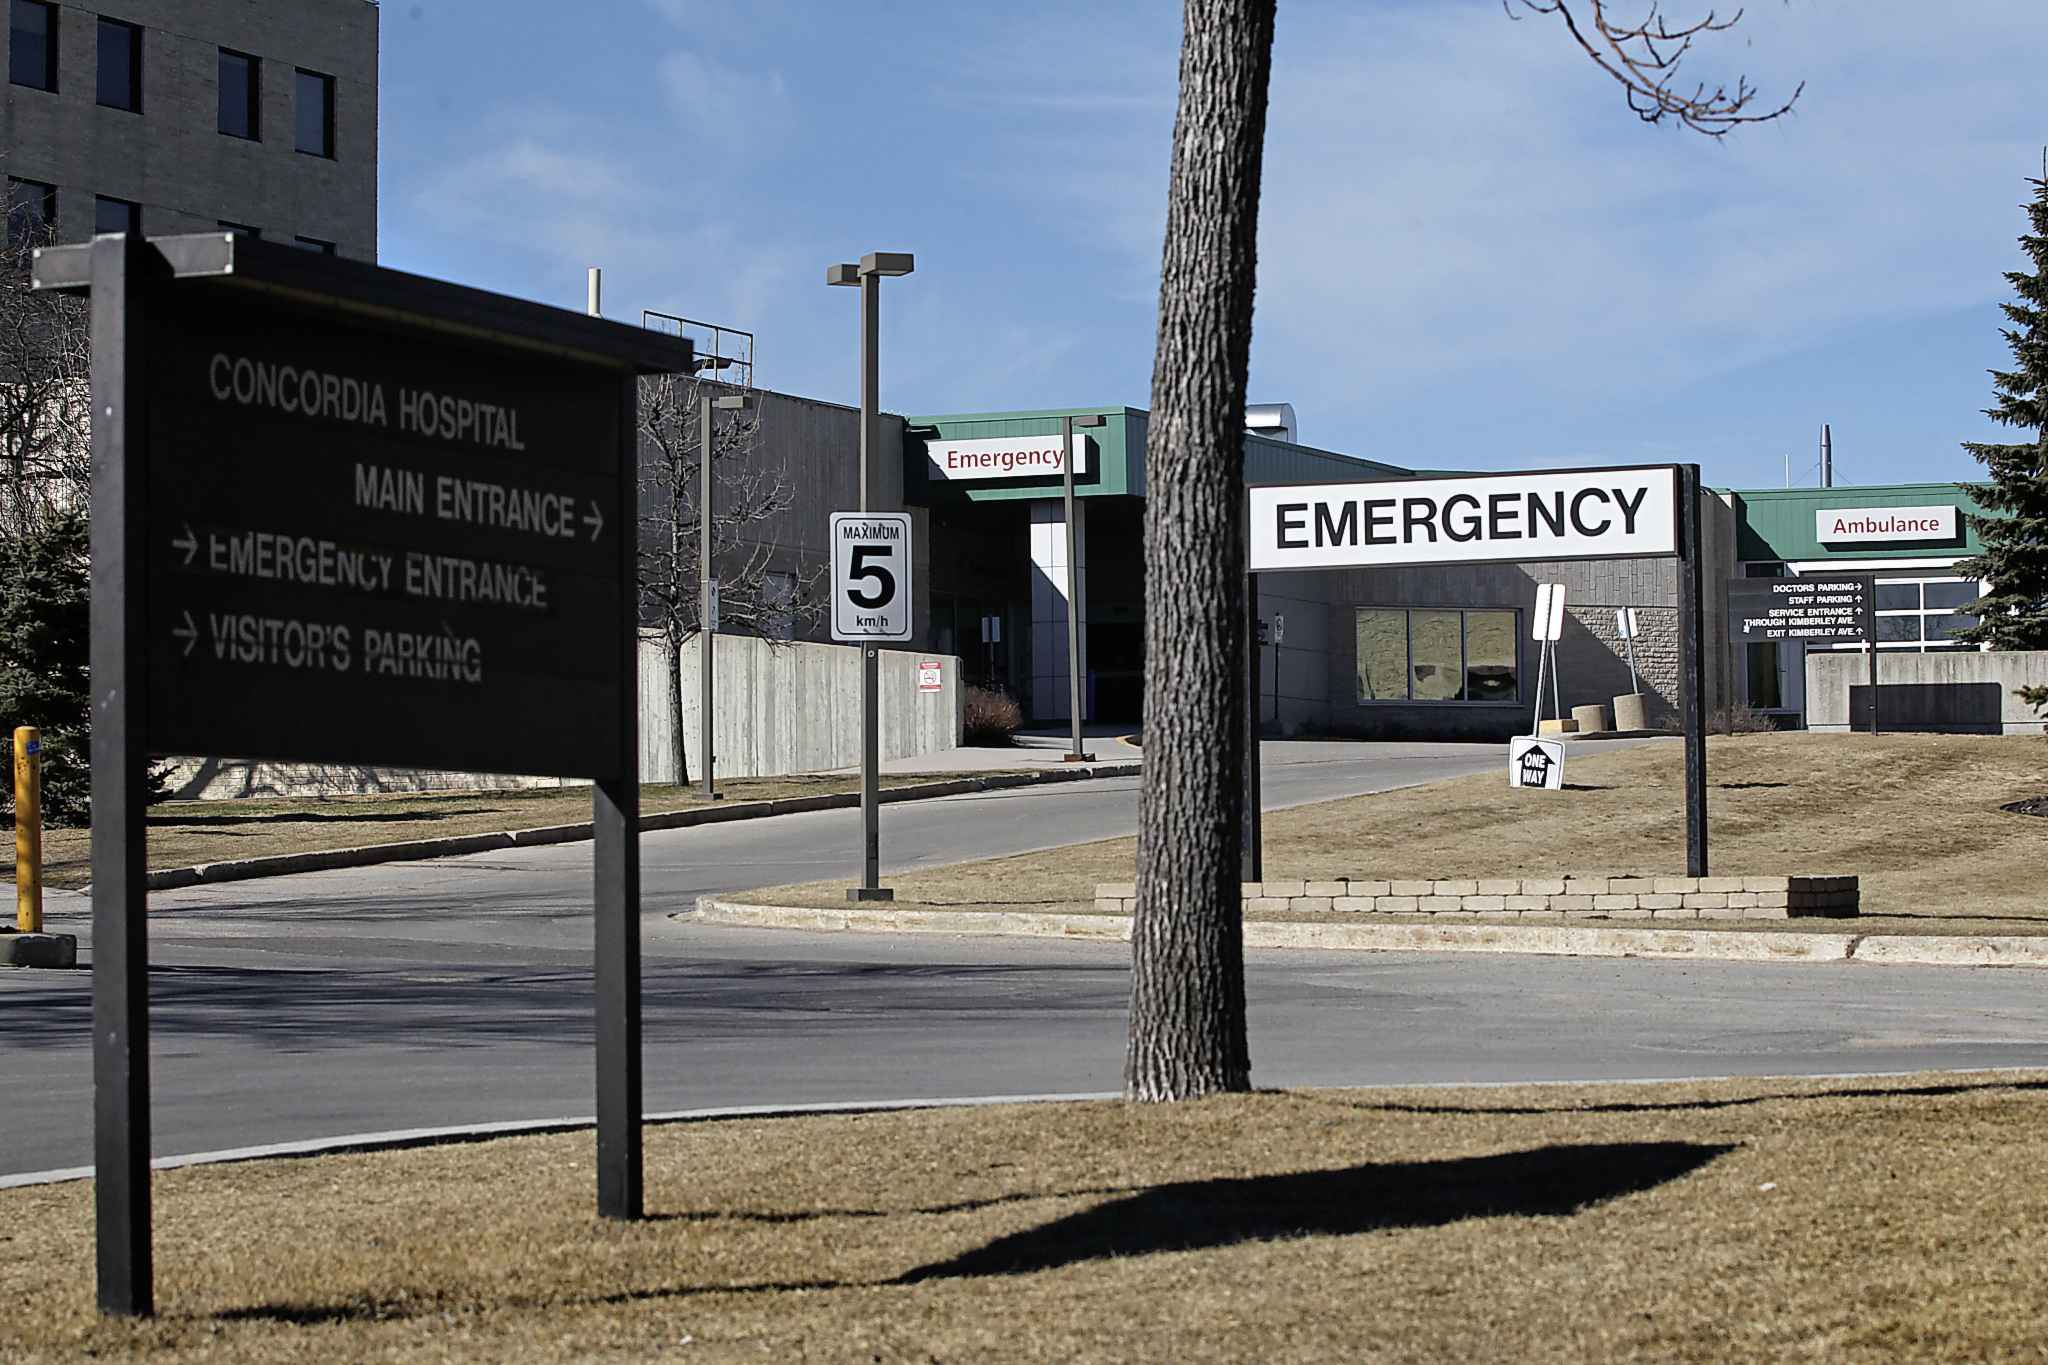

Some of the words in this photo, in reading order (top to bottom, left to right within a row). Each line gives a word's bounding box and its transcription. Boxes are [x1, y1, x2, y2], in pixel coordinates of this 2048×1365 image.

[209, 353, 388, 427] CONCORDIA
[400, 388, 525, 450] HOSPITAL
[947, 448, 1064, 471] Emergency
[355, 463, 423, 515] MAIN
[437, 476, 575, 538] ENTRANCE
[1276, 487, 1648, 549] EMERGENCY
[1833, 516, 1940, 534] Ambulance
[843, 525, 899, 540] MAXIMUM
[209, 531, 392, 591] EMERGENCY
[406, 552, 547, 608] ENTRANCE
[847, 545, 896, 609] 5
[1773, 584, 1814, 592] DOCTORS
[1818, 583, 1854, 591] PARKING
[1789, 596, 1814, 604] STAFF
[1817, 595, 1853, 603] PARKING
[1769, 609, 1804, 617] SERVICE
[1807, 608, 1853, 616] ENTRANCE
[856, 615, 889, 628] km/h
[1743, 618, 1785, 626] THROUGH
[1789, 617, 1836, 625] KIMBERLEY
[1767, 629, 1786, 637] EXIT
[1789, 628, 1836, 636] KIMBERLEY
[1837, 627, 1856, 635] AVE.
[209, 612, 350, 671] VISITOR'S
[365, 627, 481, 682] PARKING
[1525, 753, 1546, 768] ONE
[1522, 769, 1544, 784] WAY
